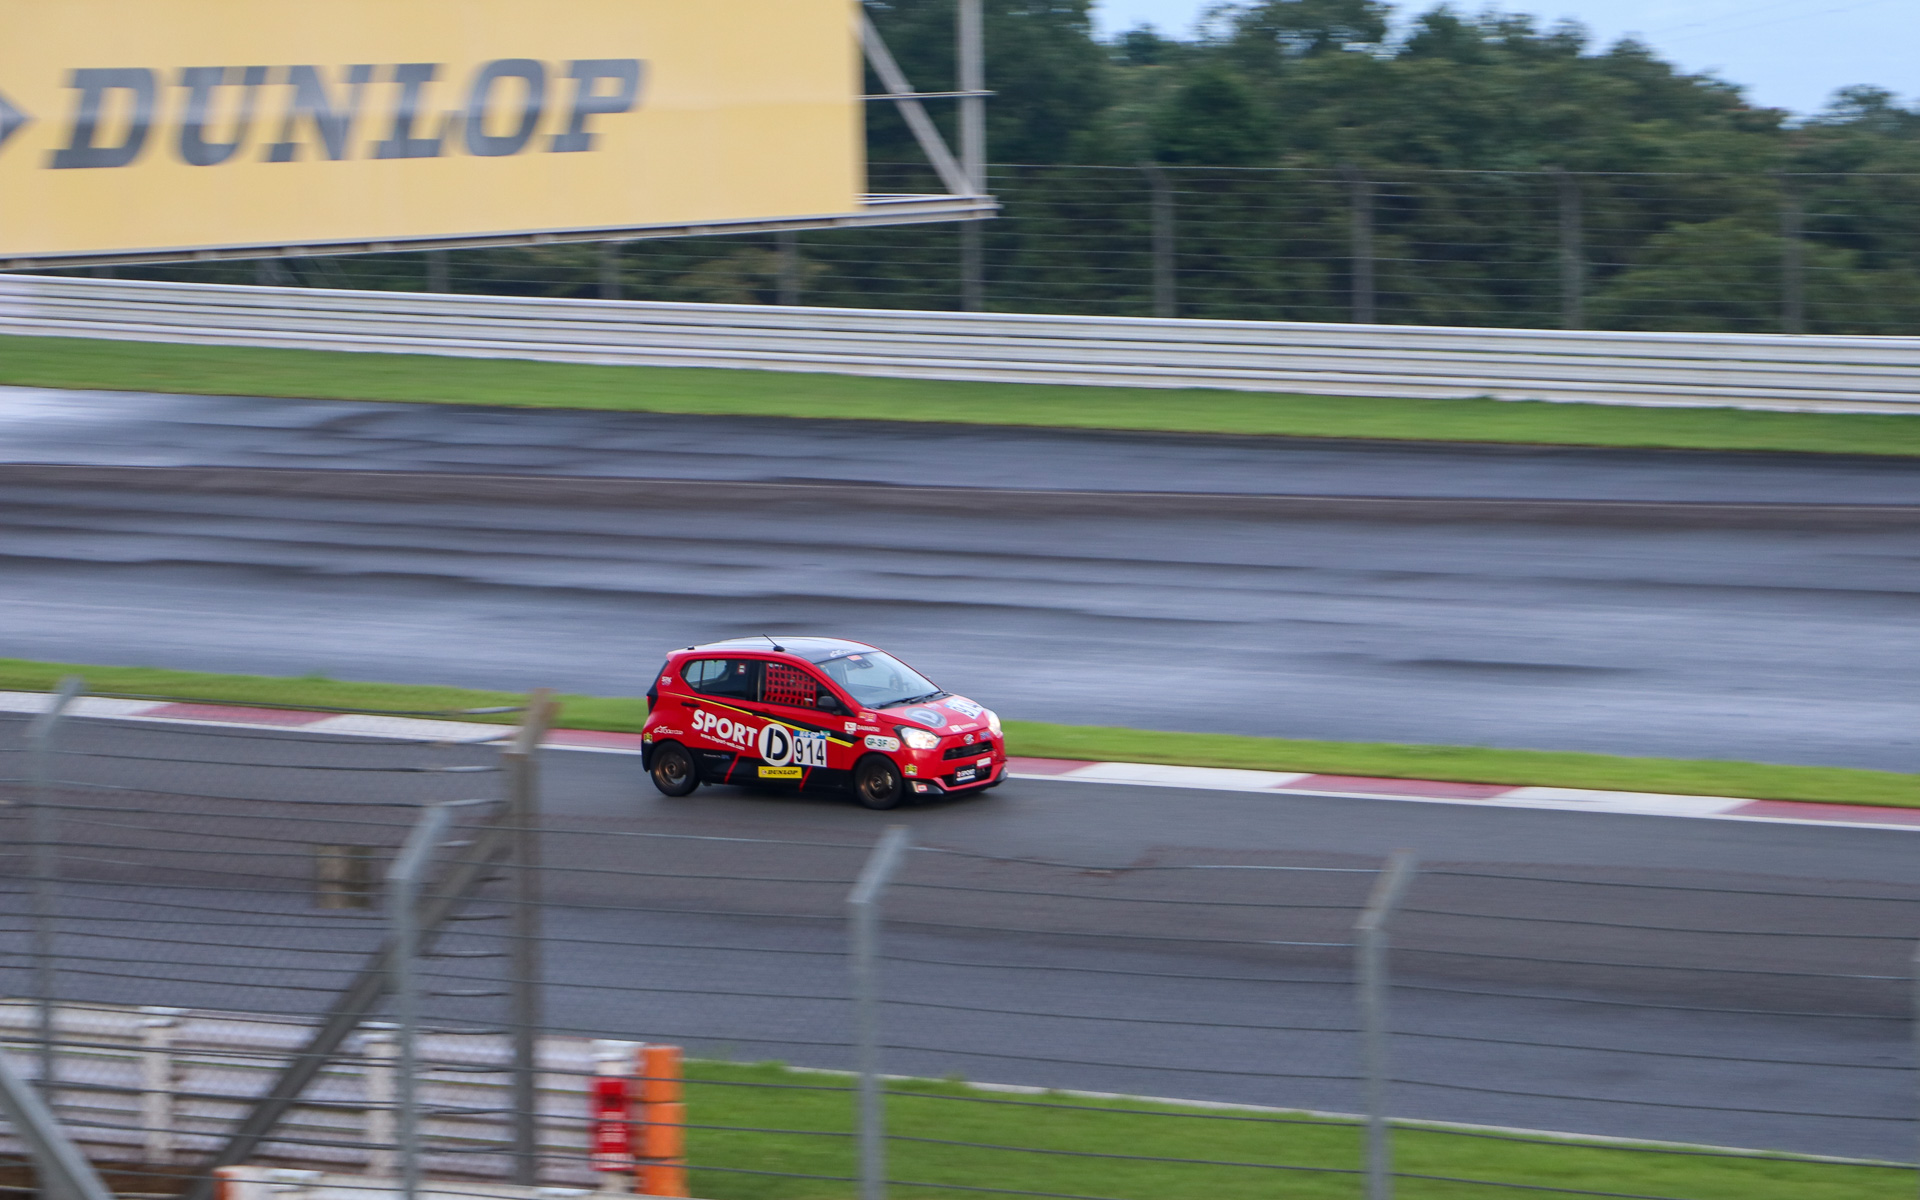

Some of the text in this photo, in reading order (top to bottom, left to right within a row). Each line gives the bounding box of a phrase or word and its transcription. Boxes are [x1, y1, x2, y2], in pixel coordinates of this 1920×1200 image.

[45, 58, 647, 169] DUNLOP
[691, 709, 758, 747] SPORT
[766, 727, 789, 761] D
[795, 738, 824, 765] 914
